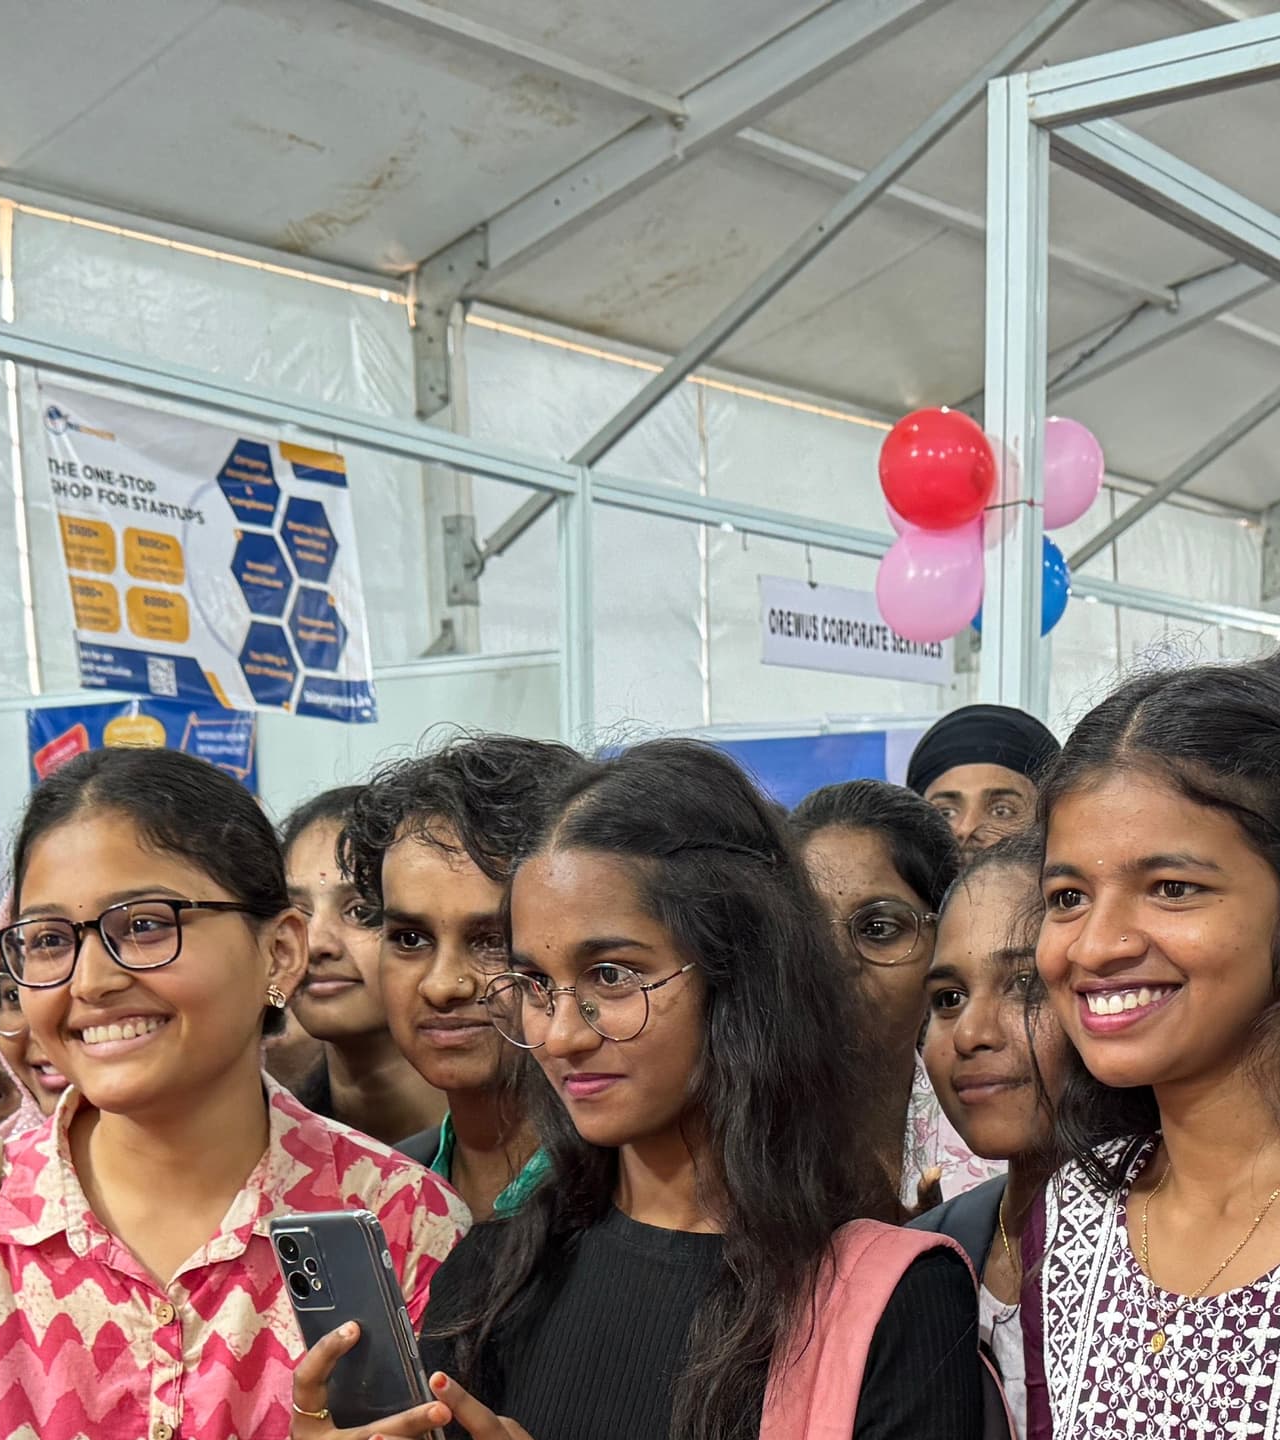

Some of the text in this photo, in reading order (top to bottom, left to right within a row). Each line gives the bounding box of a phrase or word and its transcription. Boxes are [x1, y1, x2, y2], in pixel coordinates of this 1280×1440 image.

[82, 465, 156, 494] ONE-STOP
[98, 488, 129, 509] FOR
[131, 495, 205, 525] STARTUPS
[821, 616, 887, 652] CORPORATE
